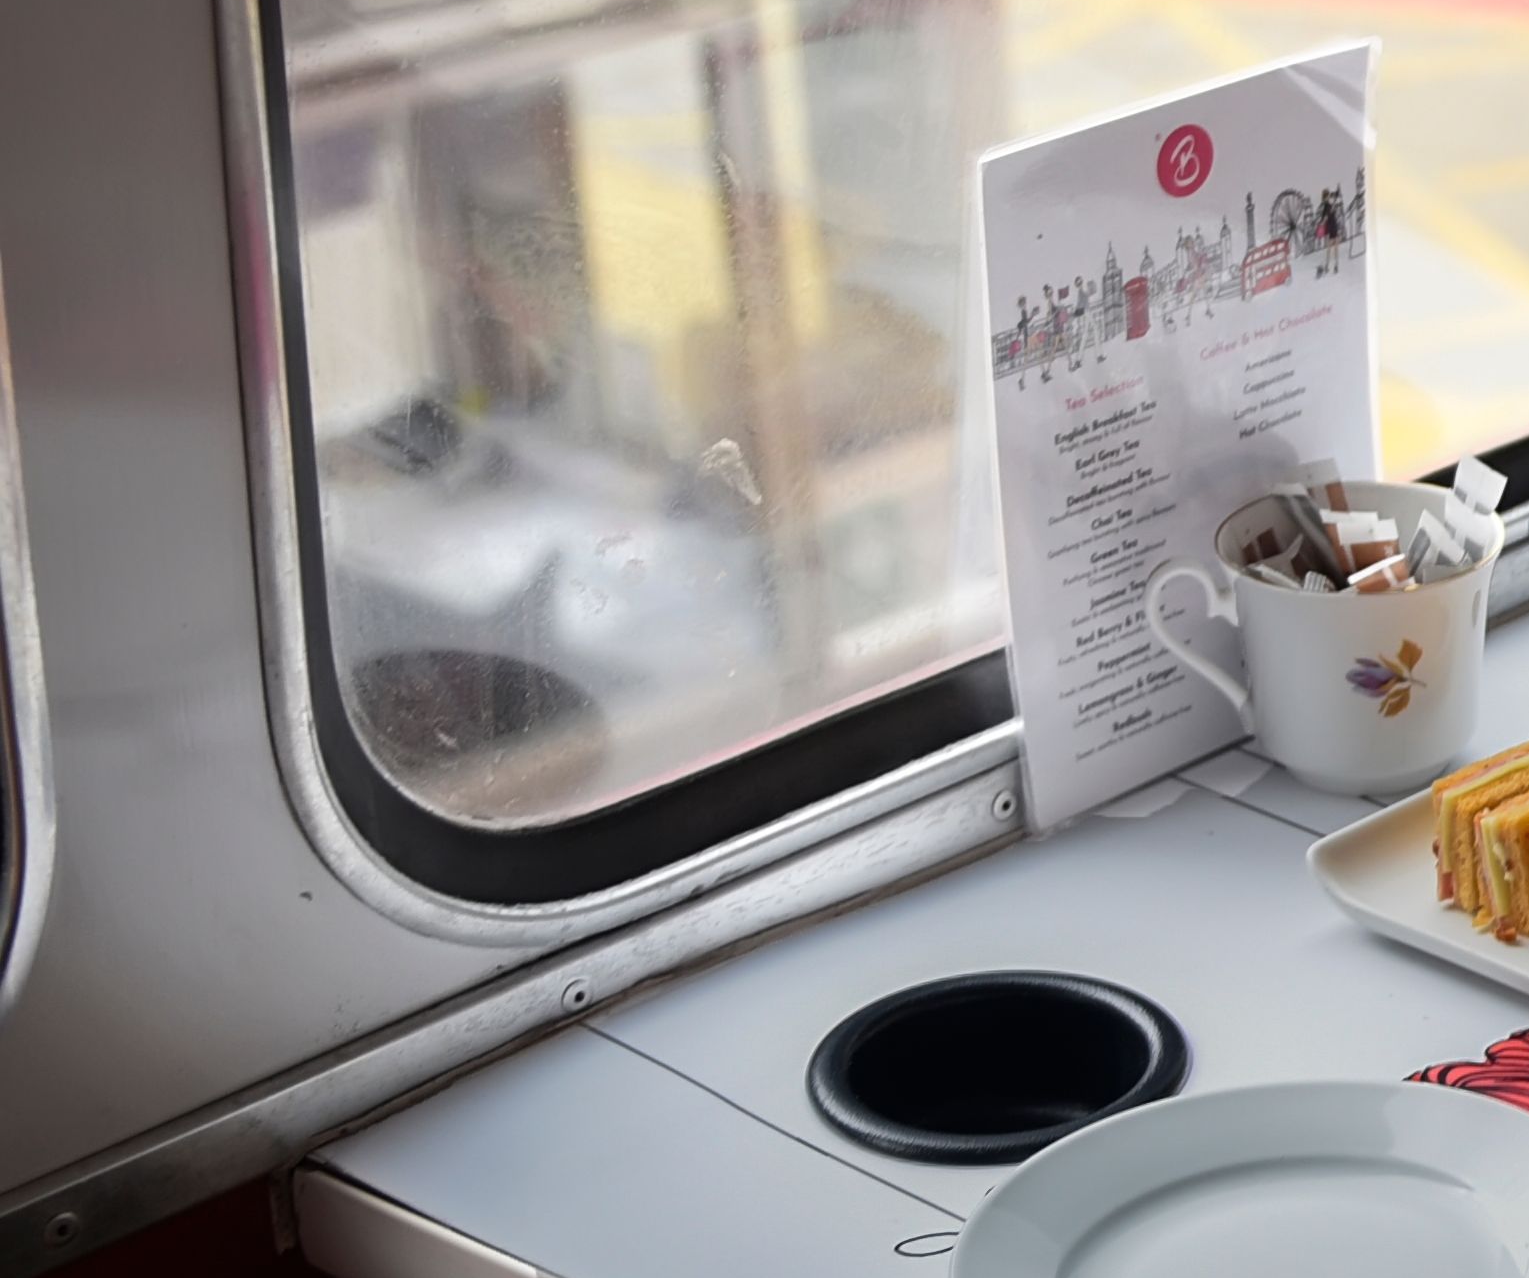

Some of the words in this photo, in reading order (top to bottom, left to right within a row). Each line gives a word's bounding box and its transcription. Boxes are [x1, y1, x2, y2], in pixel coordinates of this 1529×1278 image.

[1199, 339, 1237, 361] Coffee
[1253, 325, 1274, 339] Hot
[1278, 304, 1332, 333] Chocolate
[1064, 397, 1087, 411] Tea
[1089, 376, 1143, 403] Selection
[1053, 423, 1090, 446] English
[1091, 406, 1137, 432] Breakfast
[1140, 400, 1157, 413] Tea
[1239, 426, 1256, 440] Hot
[1257, 408, 1302, 433] Chocolate
[1074, 453, 1095, 471] Earl
[1097, 447, 1121, 462] Grey
[1123, 439, 1140, 452] Tea
[1066, 472, 1134, 508] Decaffeinated
[1135, 467, 1152, 480] Tea
[1090, 514, 1113, 531] Chai
[1116, 508, 1133, 520] Tea
[1090, 547, 1119, 564] Green
[1121, 538, 1138, 551] Tea
[1089, 587, 1127, 611] Jasmine
[1075, 631, 1095, 648] Red
[1097, 622, 1122, 639] Berry
[1124, 615, 1132, 627] &
[1097, 642, 1151, 672] Peppermint
[1077, 684, 1133, 716] Lemongrass
[1136, 677, 1143, 689] &
[1146, 665, 1177, 684] Ginger
